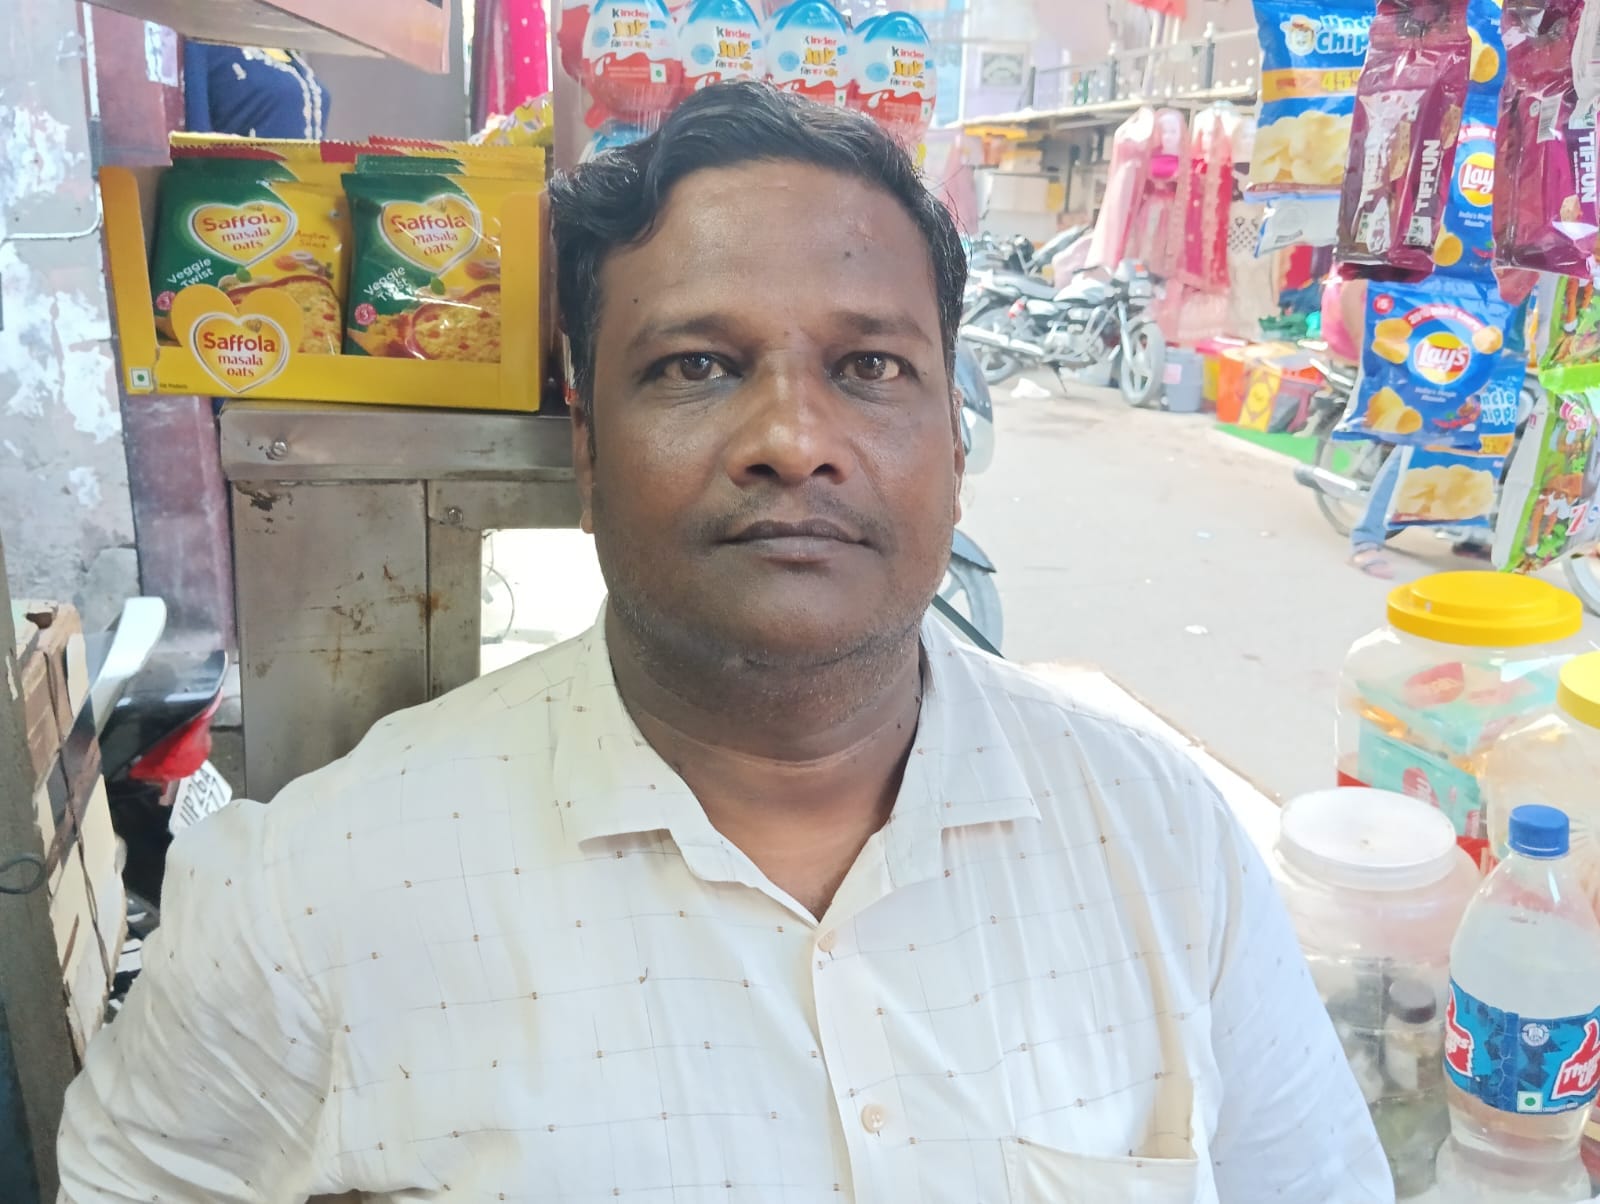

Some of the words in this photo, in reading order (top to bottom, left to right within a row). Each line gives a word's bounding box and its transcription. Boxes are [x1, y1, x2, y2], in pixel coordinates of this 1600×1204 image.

[1414, 140, 1440, 213] TIFFUN
[1579, 131, 1596, 203] TIFFUN
[202, 213, 283, 232] Saffola
[390, 213, 468, 233] Saffola
[221, 226, 272, 243] masala
[412, 229, 459, 246] masala
[232, 240, 264, 251] oats
[423, 244, 454, 257] oats
[167, 257, 213, 284] Veggie
[180, 267, 214, 288] Twist
[203, 332, 276, 353] Saffola
[218, 354, 263, 366] masala
[226, 367, 255, 377] oats
